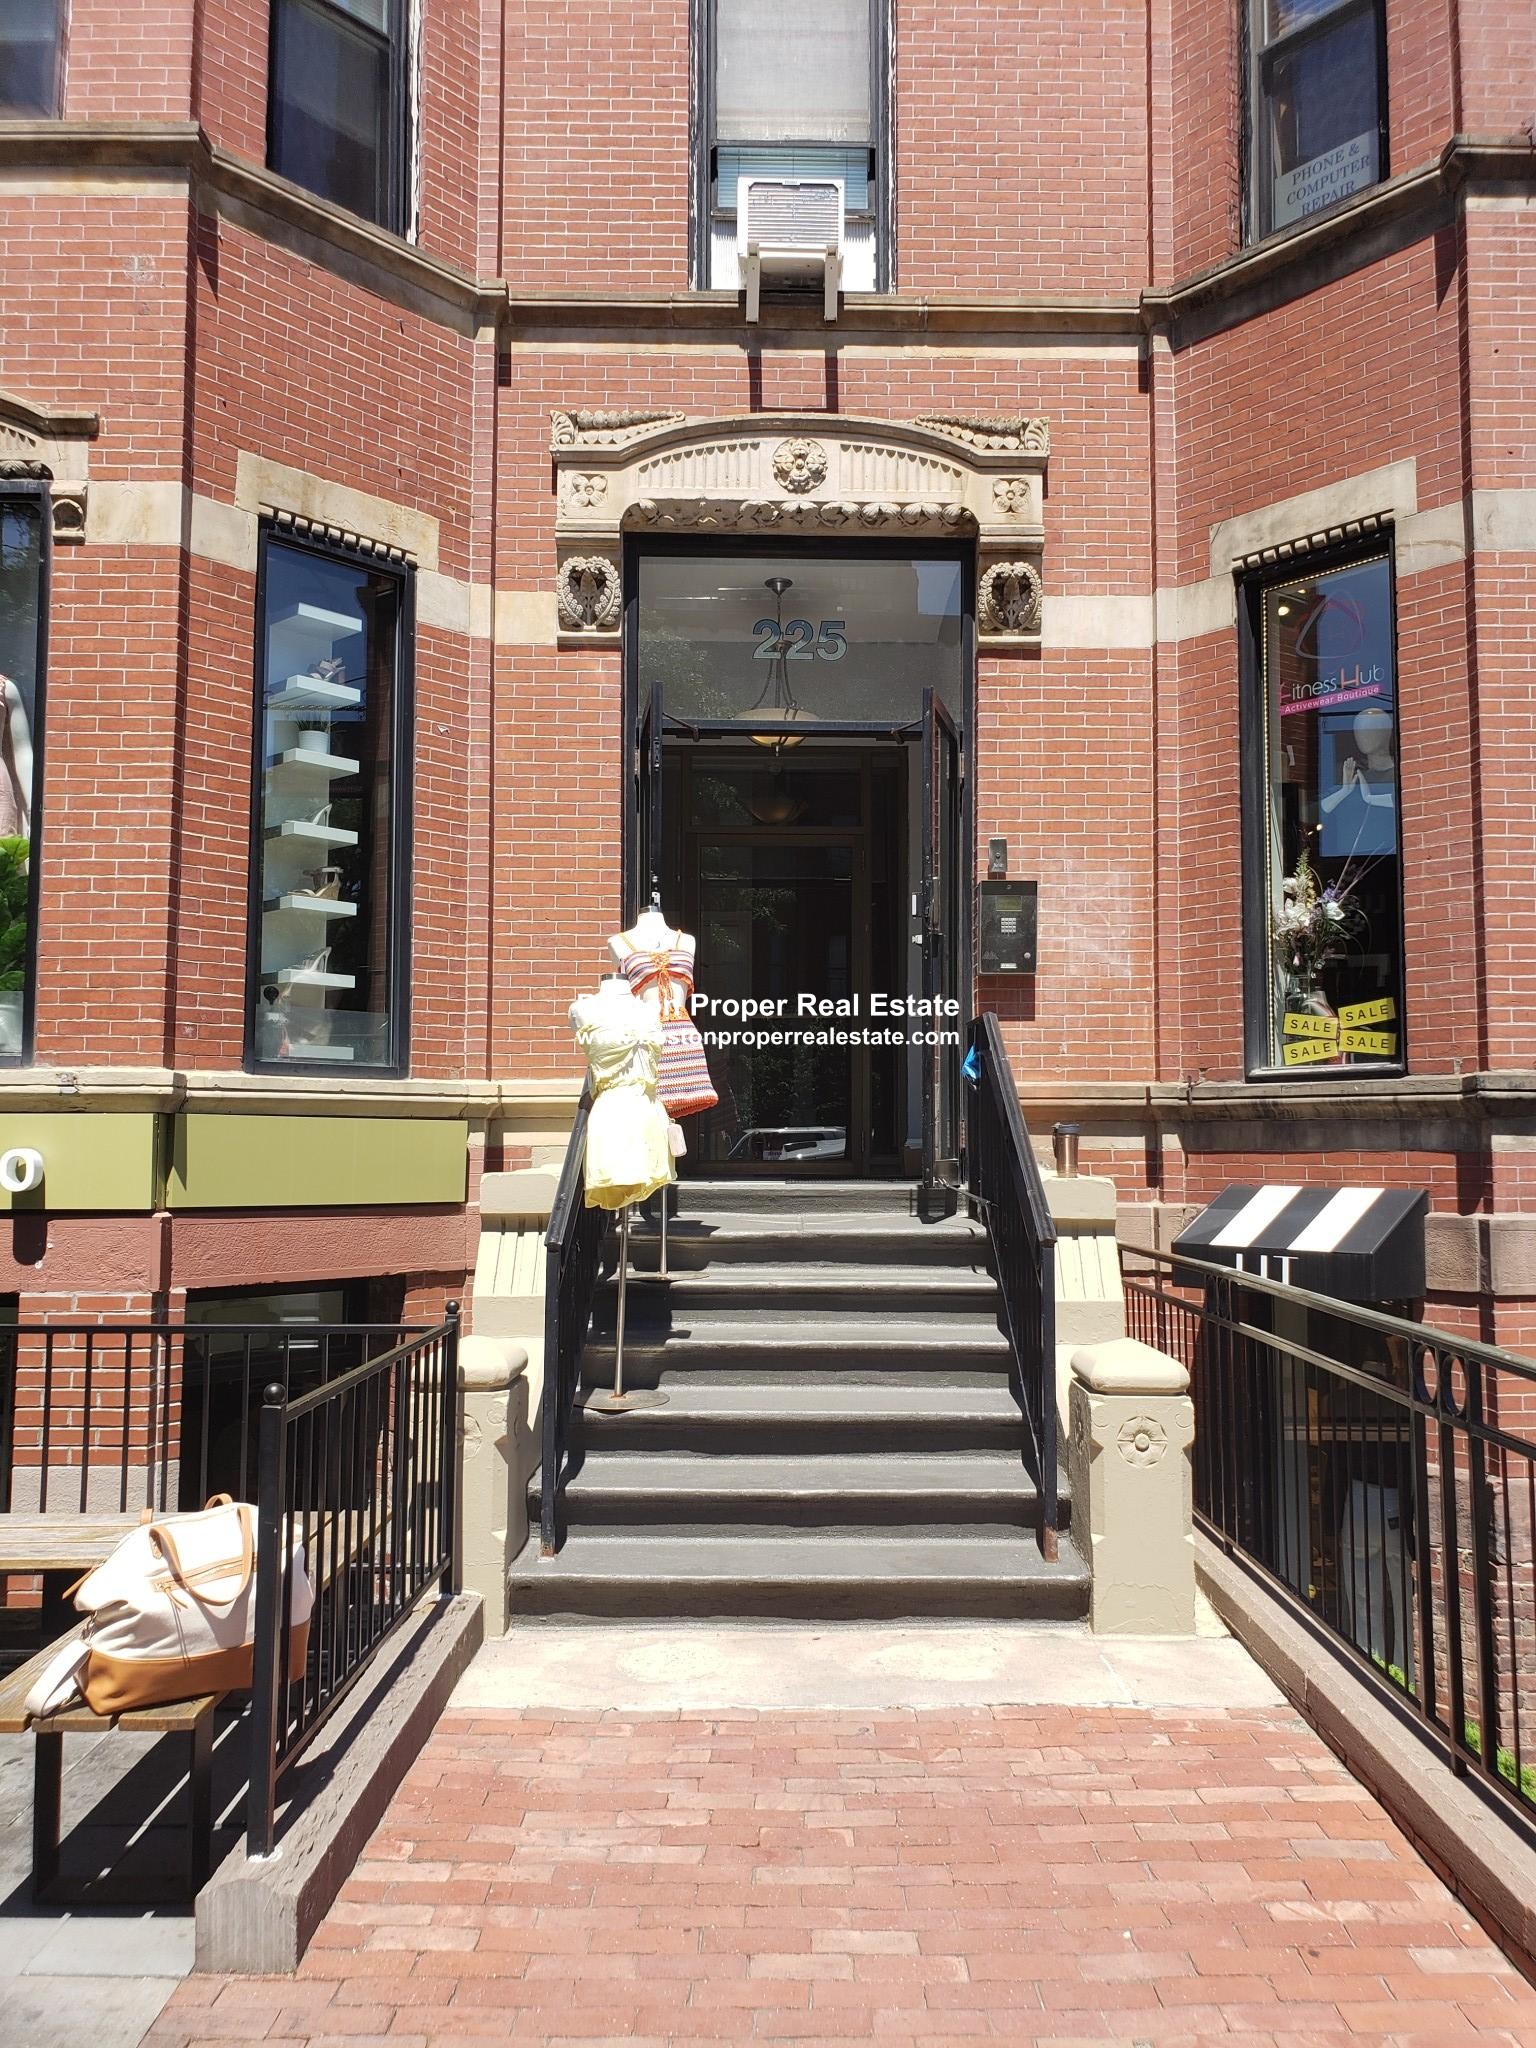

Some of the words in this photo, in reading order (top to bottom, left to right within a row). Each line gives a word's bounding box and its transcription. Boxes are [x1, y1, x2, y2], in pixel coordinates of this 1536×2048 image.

[1292, 150, 1345, 186] PHONE
[1347, 143, 1360, 155] &
[1286, 155, 1370, 206] COMPUTER
[1301, 180, 1355, 216] REPAIR
[752, 618, 848, 661] 225
[1340, 664, 1385, 689] Hub
[1284, 696, 1335, 714] Activewear
[1337, 686, 1379, 702] Boutique
[1290, 1019, 1331, 1033] SALE
[1345, 1004, 1389, 1022] SALE
[1290, 1042, 1331, 1058] SALE
[1346, 1035, 1390, 1049] SALE
